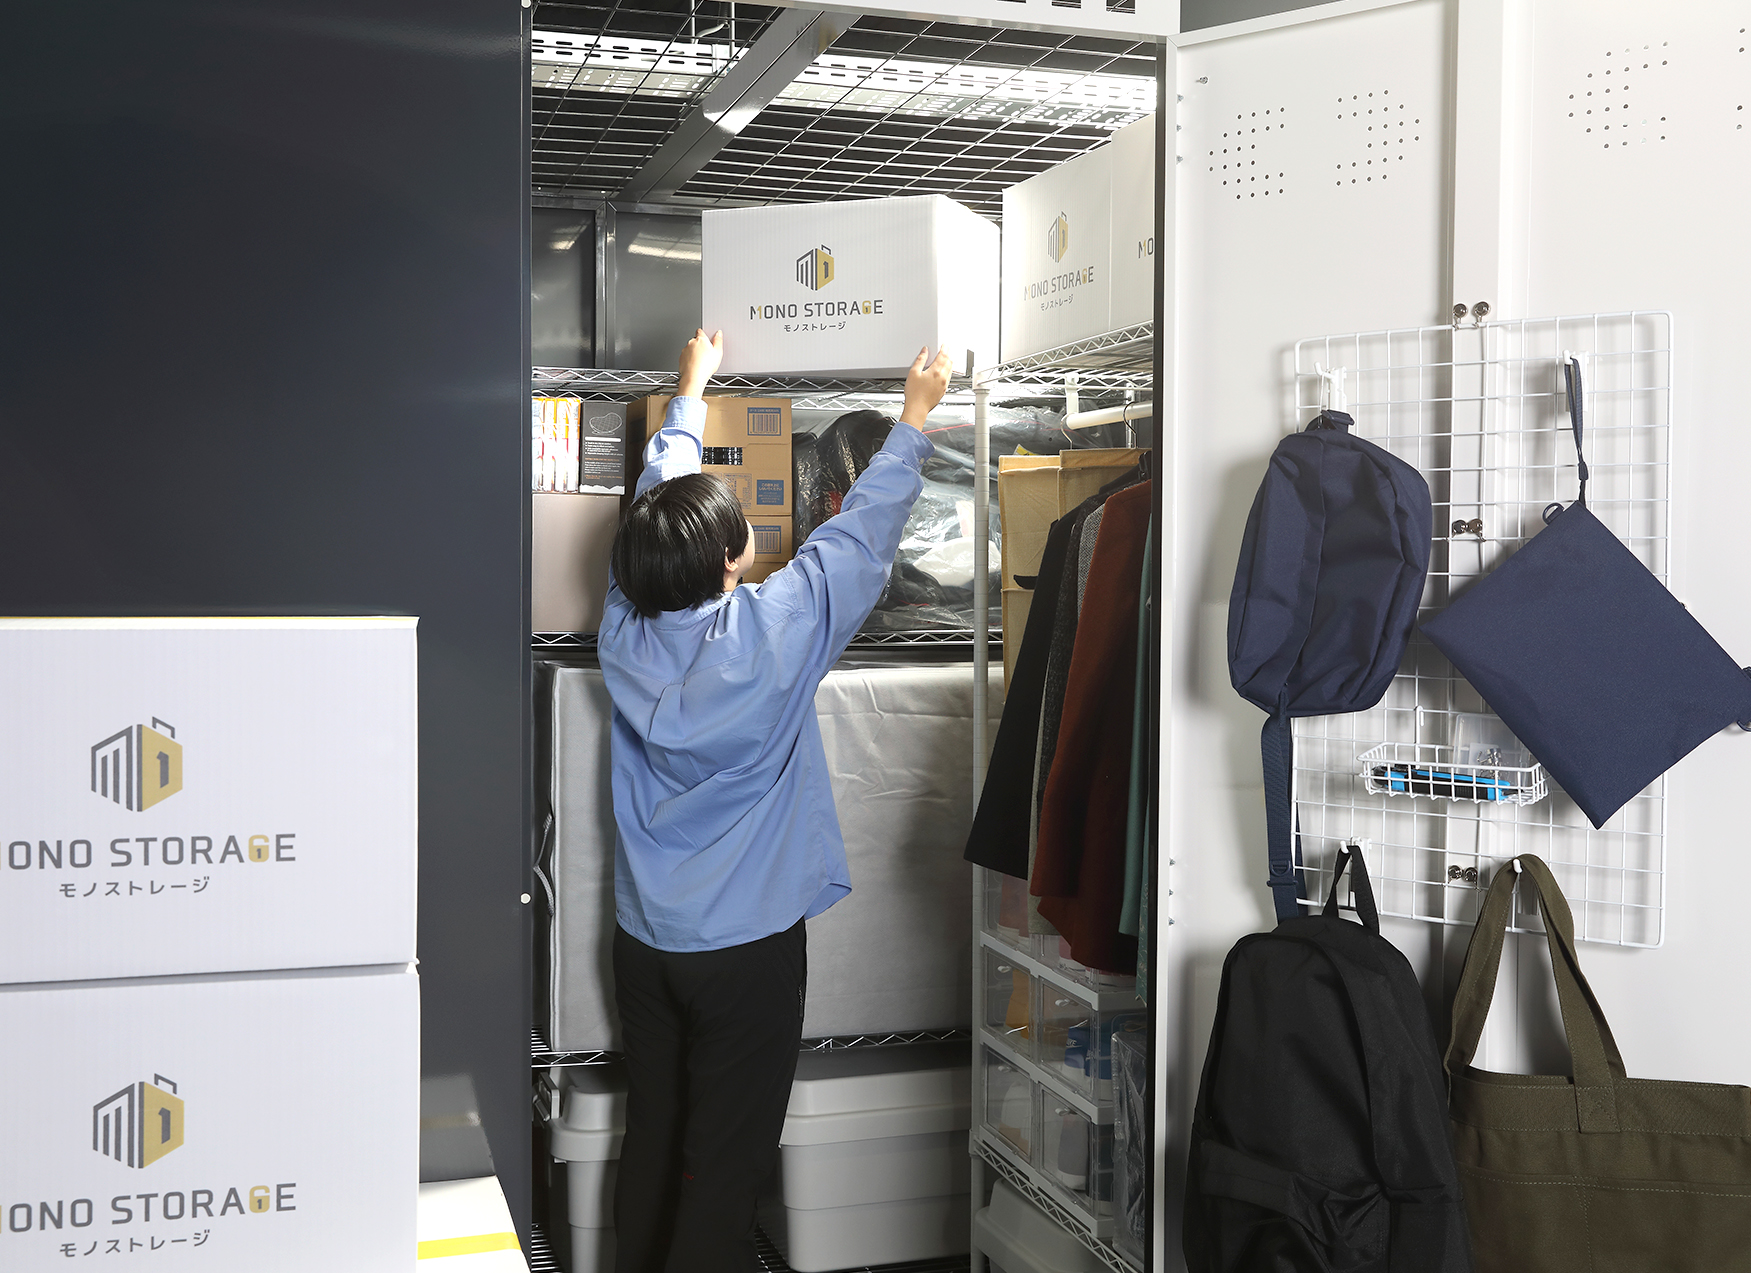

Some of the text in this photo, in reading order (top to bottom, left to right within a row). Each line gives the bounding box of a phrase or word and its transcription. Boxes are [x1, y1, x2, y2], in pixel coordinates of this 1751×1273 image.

[1138, 236, 1154, 259] MO
[1024, 266, 1094, 301] MONO STORAGE
[750, 299, 884, 321] MONO STORAGE
[1040, 294, 1074, 311] モノストレージ
[783, 320, 847, 333] モノストレージ
[0, 833, 296, 871] ONO STORAGE
[58, 875, 210, 898] モノストレージ
[0, 1182, 297, 1234] ONO STORAGE
[58, 1229, 211, 1259] モノストレージ
